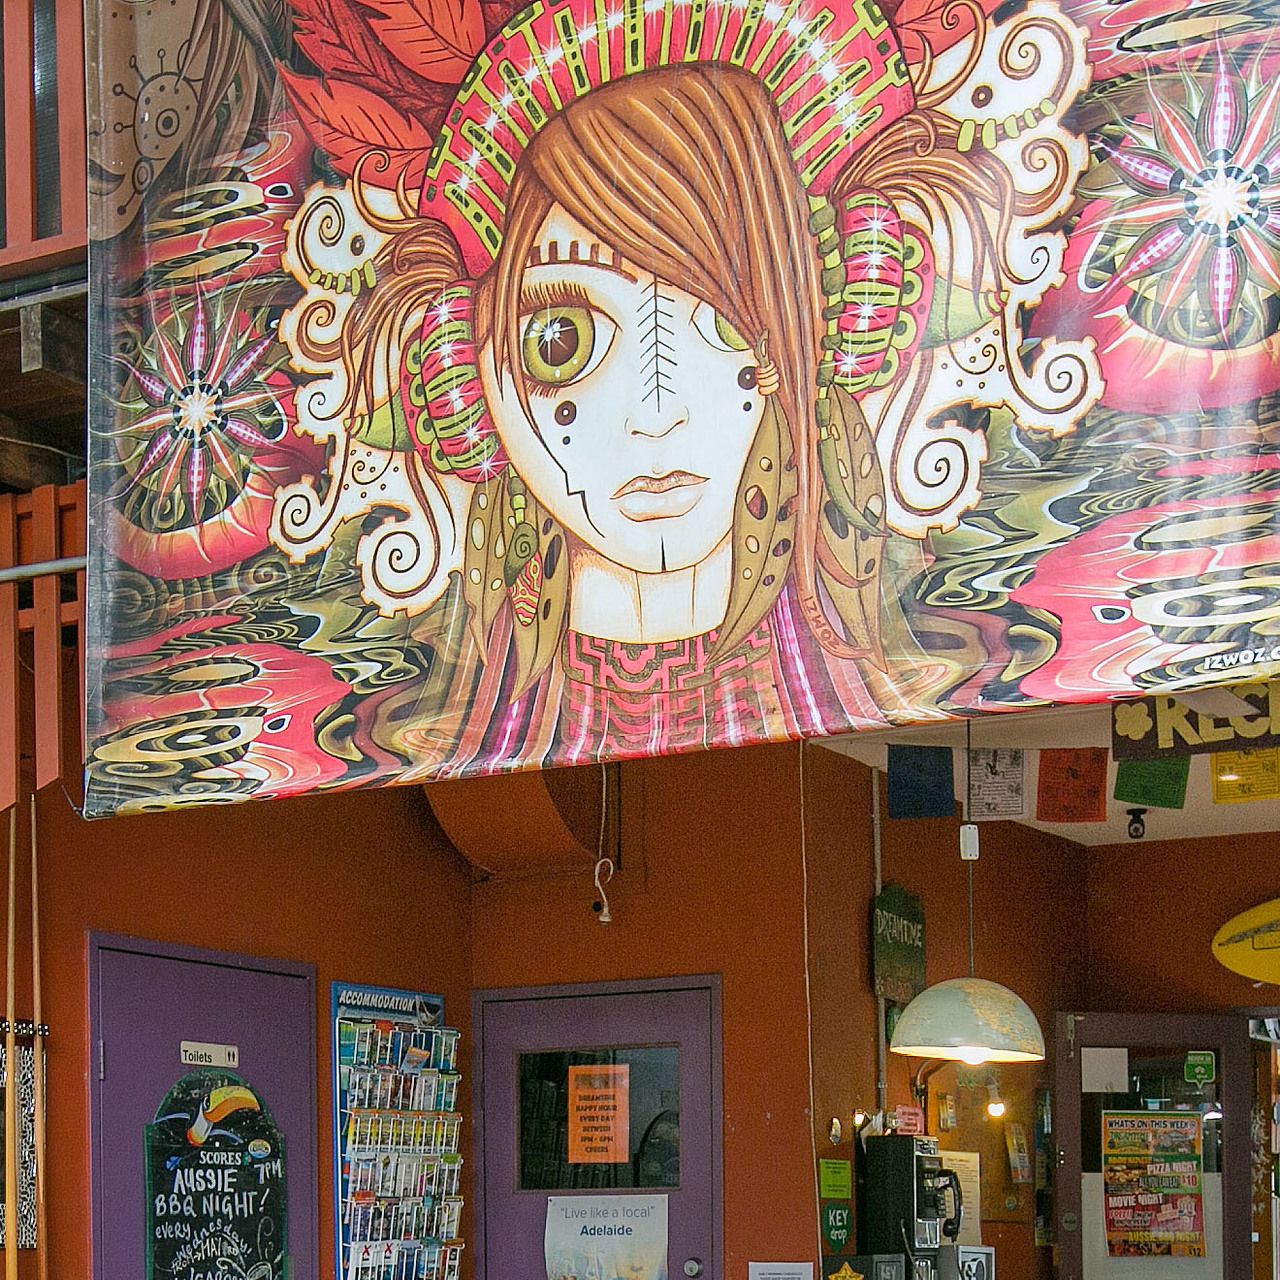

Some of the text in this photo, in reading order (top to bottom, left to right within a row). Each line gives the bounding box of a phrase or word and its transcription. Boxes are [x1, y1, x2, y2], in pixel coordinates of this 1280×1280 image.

[339, 990, 415, 1012] ACCOMMODATION
[182, 1049, 212, 1063] Toilets
[1137, 1119, 1148, 1129] ON
[1151, 1119, 1168, 1129] THIS
[1170, 1120, 1188, 1129] WEEK
[199, 1150, 242, 1165] SCORES
[254, 1158, 282, 1184] 7PM
[1147, 1163, 1171, 1175] PIZZA
[174, 1168, 238, 1195] AUSSIE
[155, 1194, 197, 1217] BBQ
[1109, 1193, 1163, 1208] MOVIE NIGHT
[590, 1207, 609, 1218] like
[612, 1210, 619, 1218] a
[828, 1208, 849, 1226] KEY
[580, 1225, 633, 1236] Adelaide
[830, 1229, 848, 1244] drop
